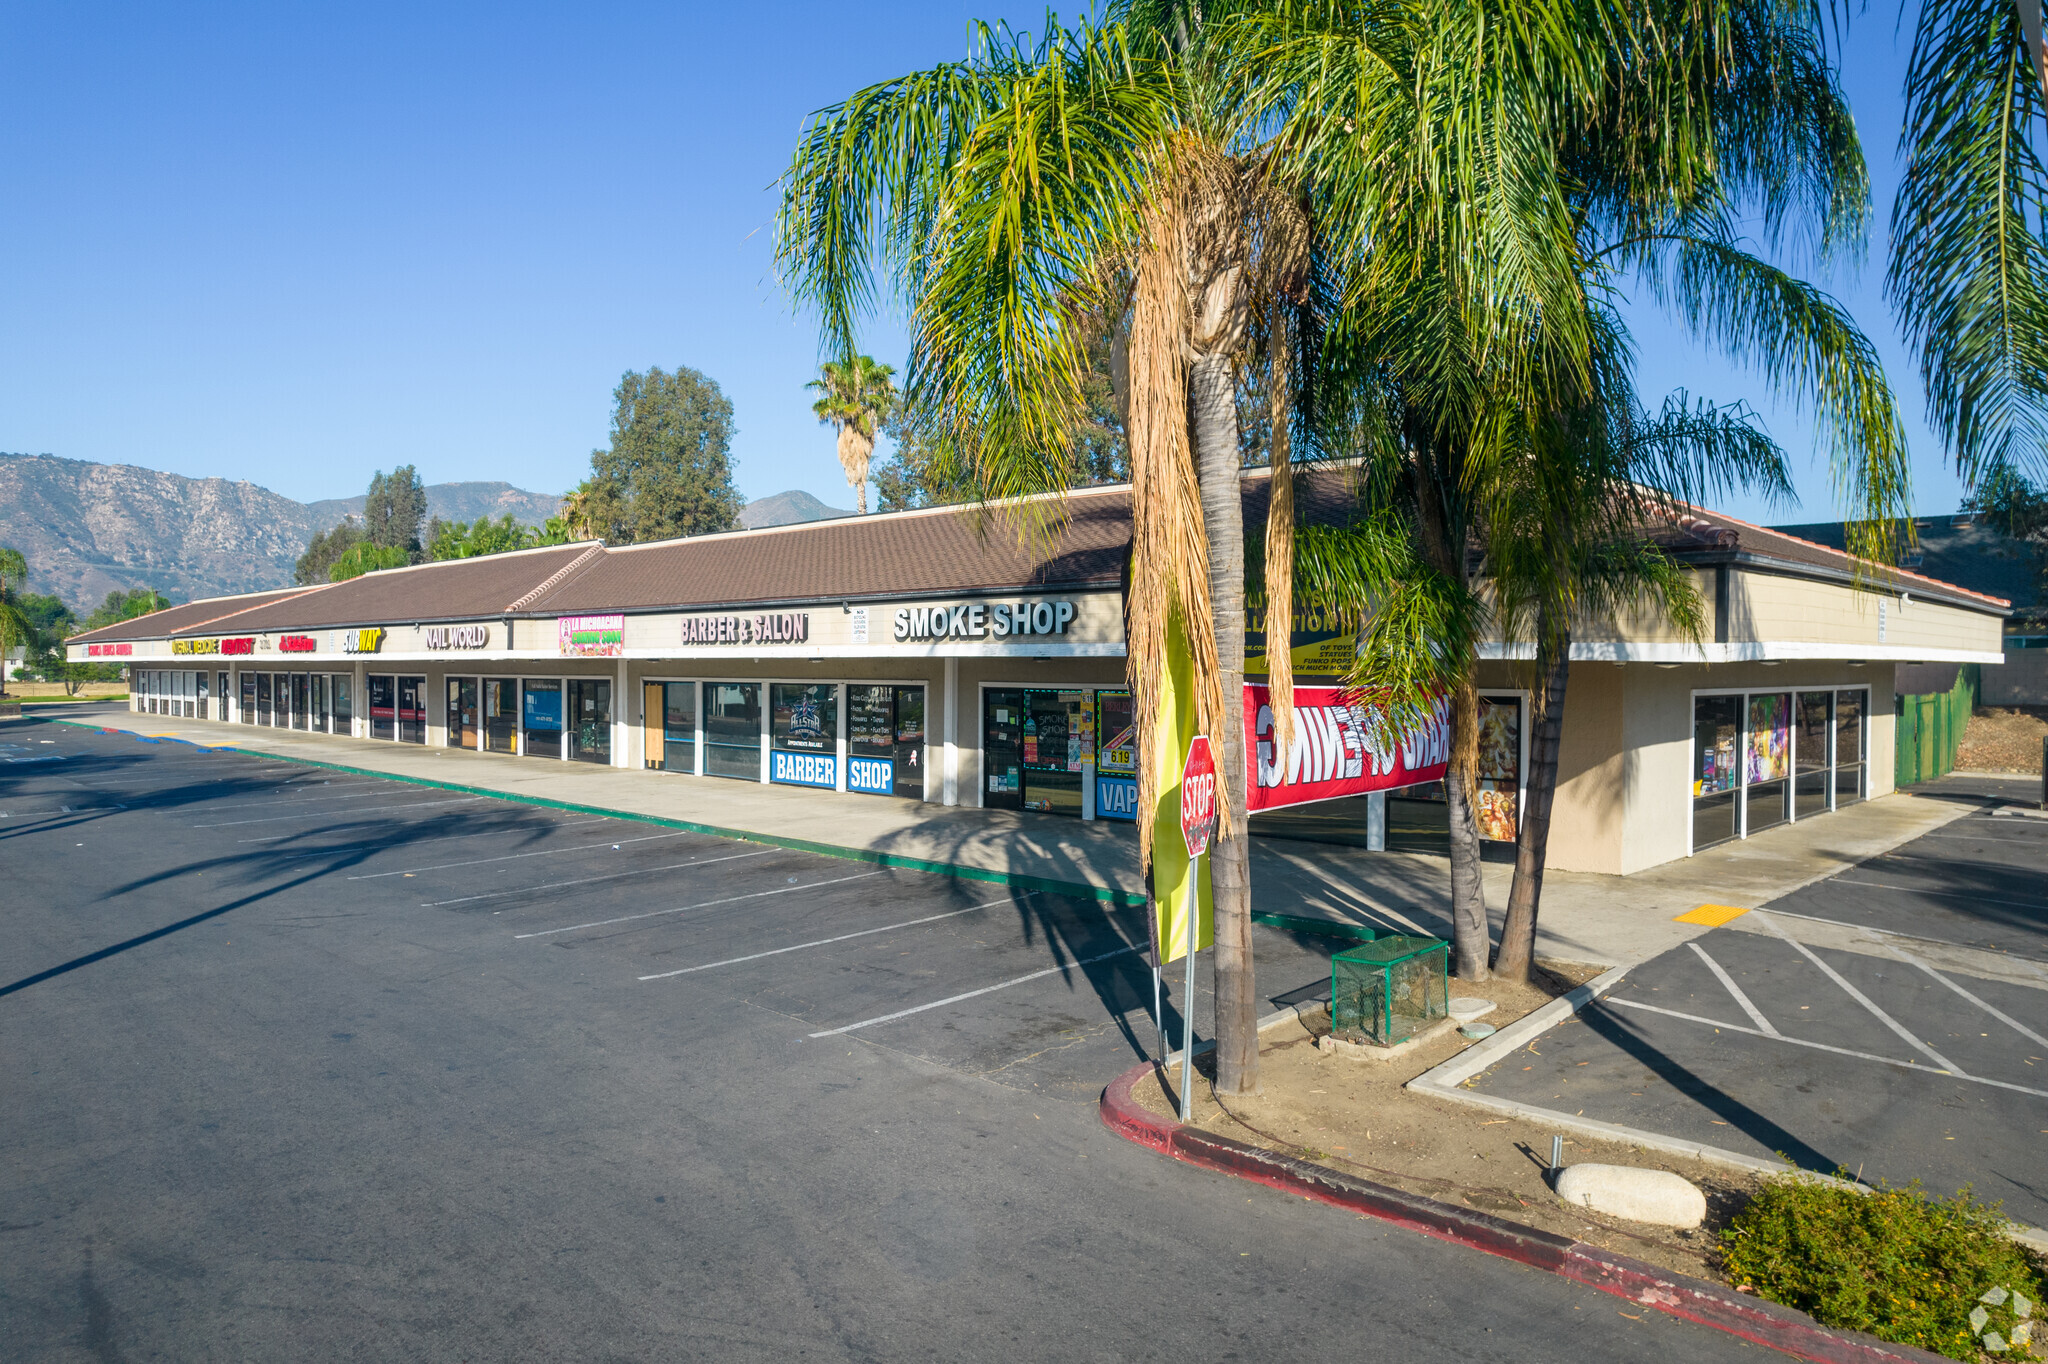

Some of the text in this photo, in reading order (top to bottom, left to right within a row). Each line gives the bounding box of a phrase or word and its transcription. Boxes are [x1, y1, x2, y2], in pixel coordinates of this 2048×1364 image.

[572, 616, 622, 630] LA MICHOACANA
[681, 614, 804, 642] BARBER & SALON
[894, 605, 985, 638] SMOKE
[993, 601, 1073, 636] SHOP
[221, 638, 255, 654] DENTIST
[344, 627, 382, 651] SUBWAY
[426, 626, 486, 648] NAIL WORLD
[572, 630, 622, 644] COMING SOON
[1038, 714, 1068, 725] SMOKE
[1042, 726, 1066, 735] SHOP
[1111, 750, 1130, 763] 6.19
[776, 754, 834, 784] BARBER
[851, 760, 892, 790] SHOP
[1184, 773, 1214, 820] STOP
